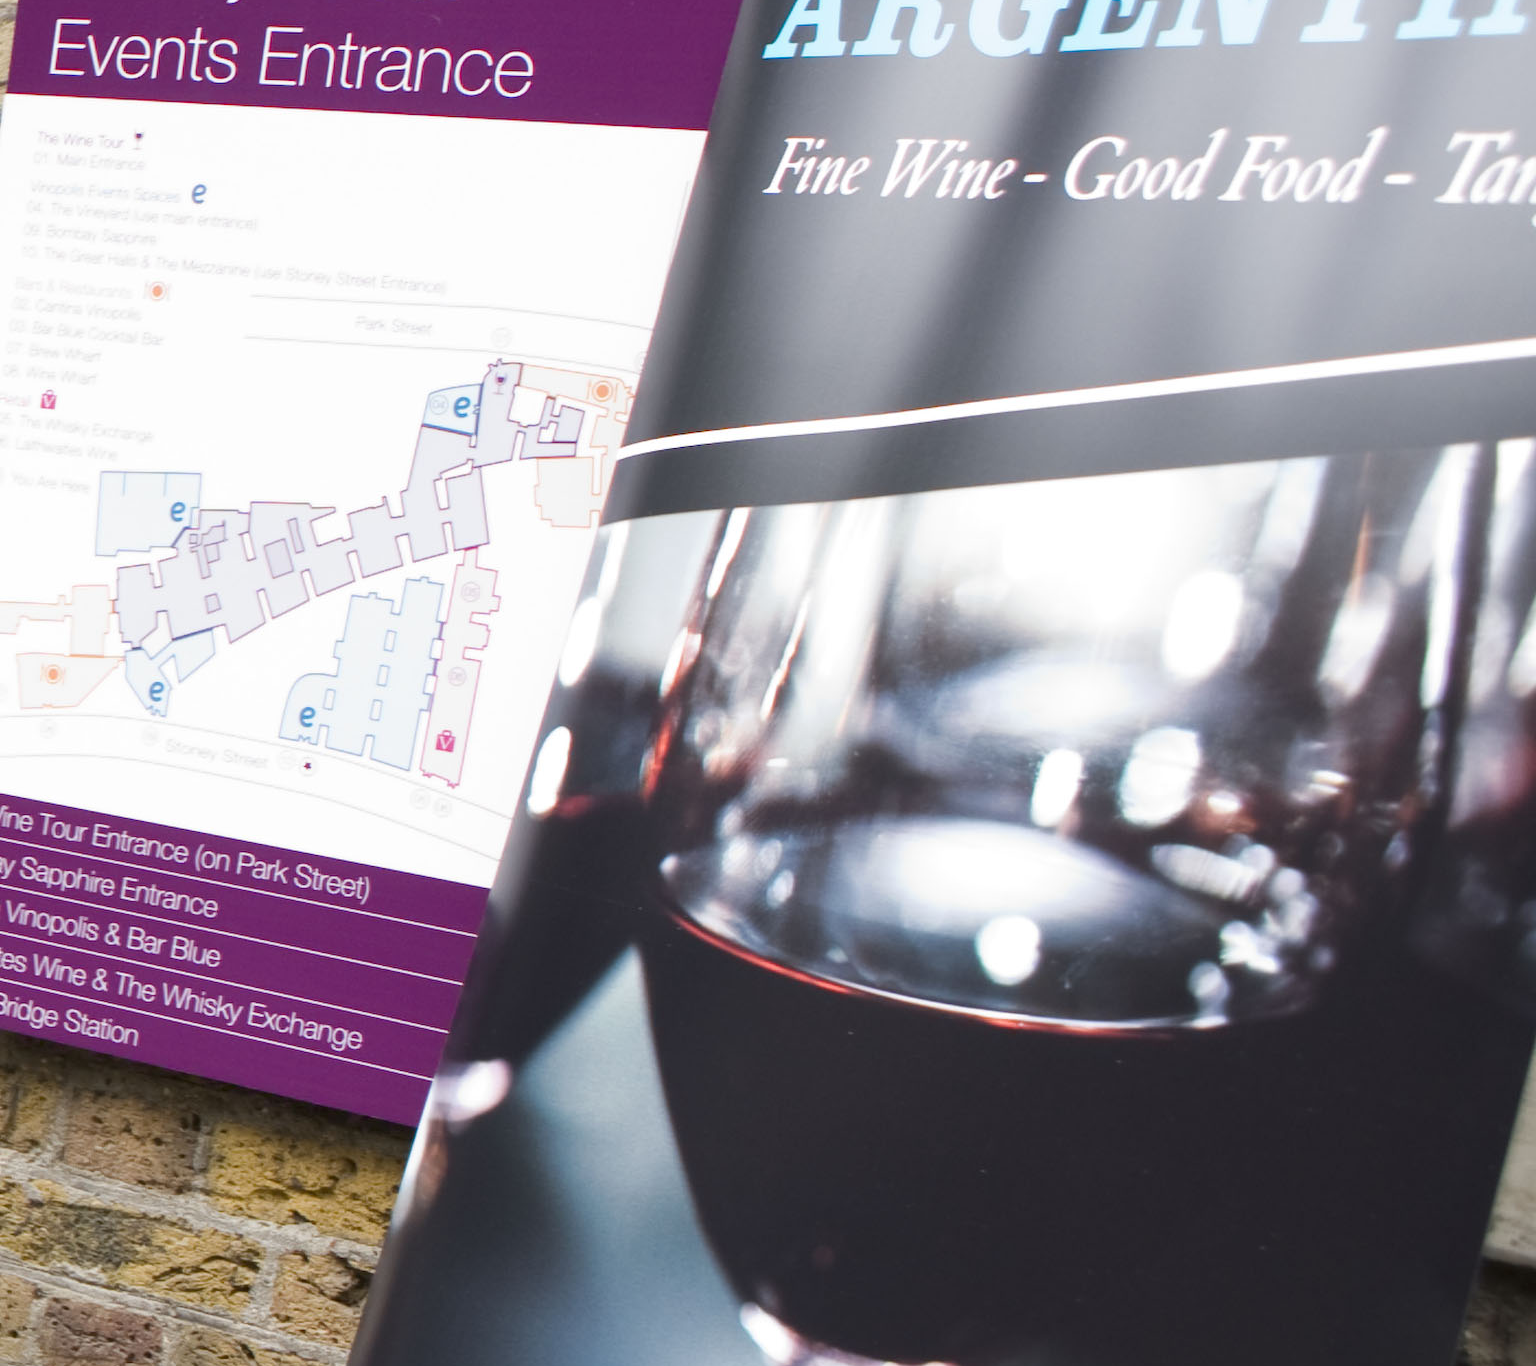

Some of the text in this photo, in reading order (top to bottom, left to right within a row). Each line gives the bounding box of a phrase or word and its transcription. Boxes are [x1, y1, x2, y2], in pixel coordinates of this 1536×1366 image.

[48, 19, 535, 100] Events Entrance
[36, 130, 59, 146] The
[63, 132, 95, 148] Wine
[762, 135, 870, 197] Fine
[879, 137, 1017, 201] Wine
[1063, 127, 1230, 203] Good
[1218, 126, 1390, 203] Food
[1433, 129, 1536, 228] Tan
[354, 314, 432, 337] Park Street
[223, 748, 269, 770] Street
[19, 855, 115, 899] Sapphire
[120, 877, 219, 920] Entrance
[39, 812, 88, 844] Tour
[93, 822, 190, 865] Entrance
[195, 843, 231, 874] (on
[236, 852, 290, 885] Park
[293, 863, 371, 905] Street)
[4, 898, 100, 946] Vinopolis
[105, 918, 121, 946] &
[127, 925, 166, 957] Bar
[171, 935, 222, 969] Blue
[33, 952, 87, 988] Wine
[92, 965, 108, 992] &
[115, 971, 157, 1003] The
[162, 981, 243, 1027] Whisky
[247, 1001, 364, 1053] Exchange
[63, 1007, 140, 1047] Station
